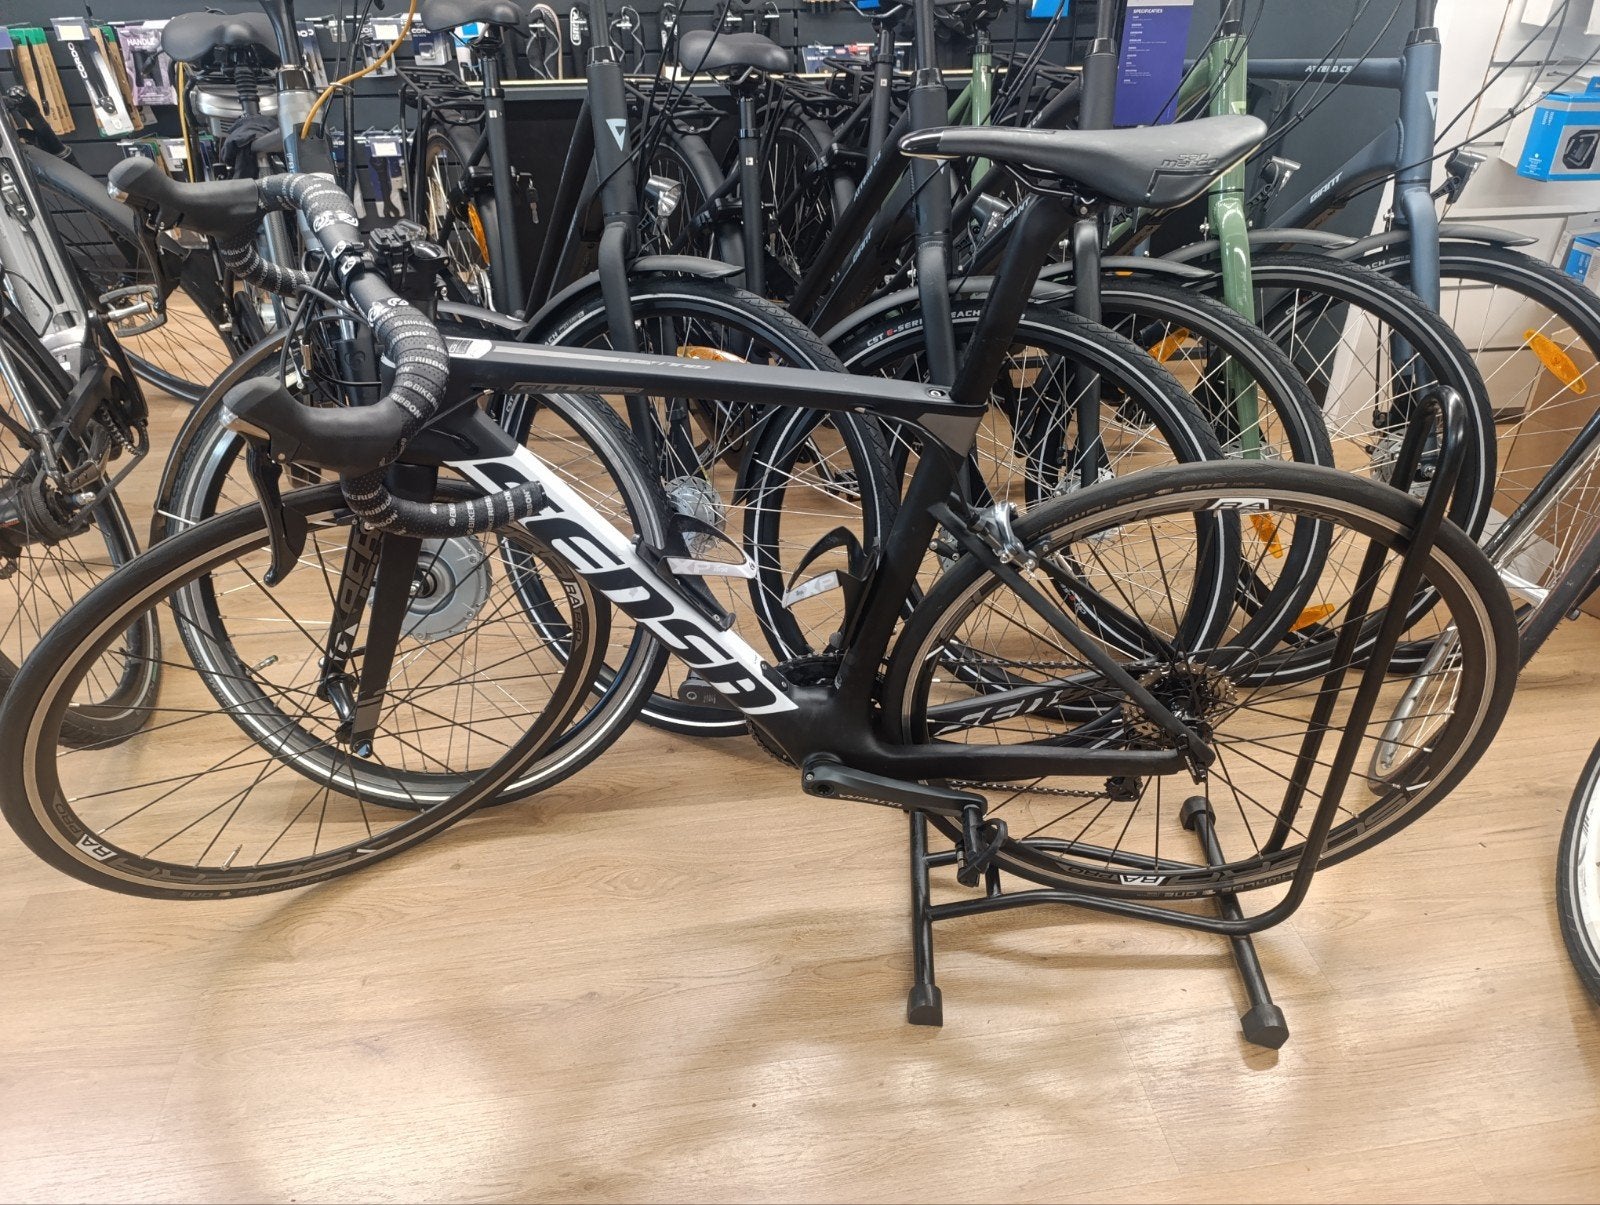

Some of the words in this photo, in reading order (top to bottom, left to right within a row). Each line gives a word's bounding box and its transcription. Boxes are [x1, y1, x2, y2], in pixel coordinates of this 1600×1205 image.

[67, 42, 88, 79] CORDO
[1310, 170, 1344, 204] GIANT
[1002, 195, 1032, 229] GIANT
[867, 333, 884, 347] CST
[564, 582, 584, 609] RA
[78, 834, 114, 861] RA
